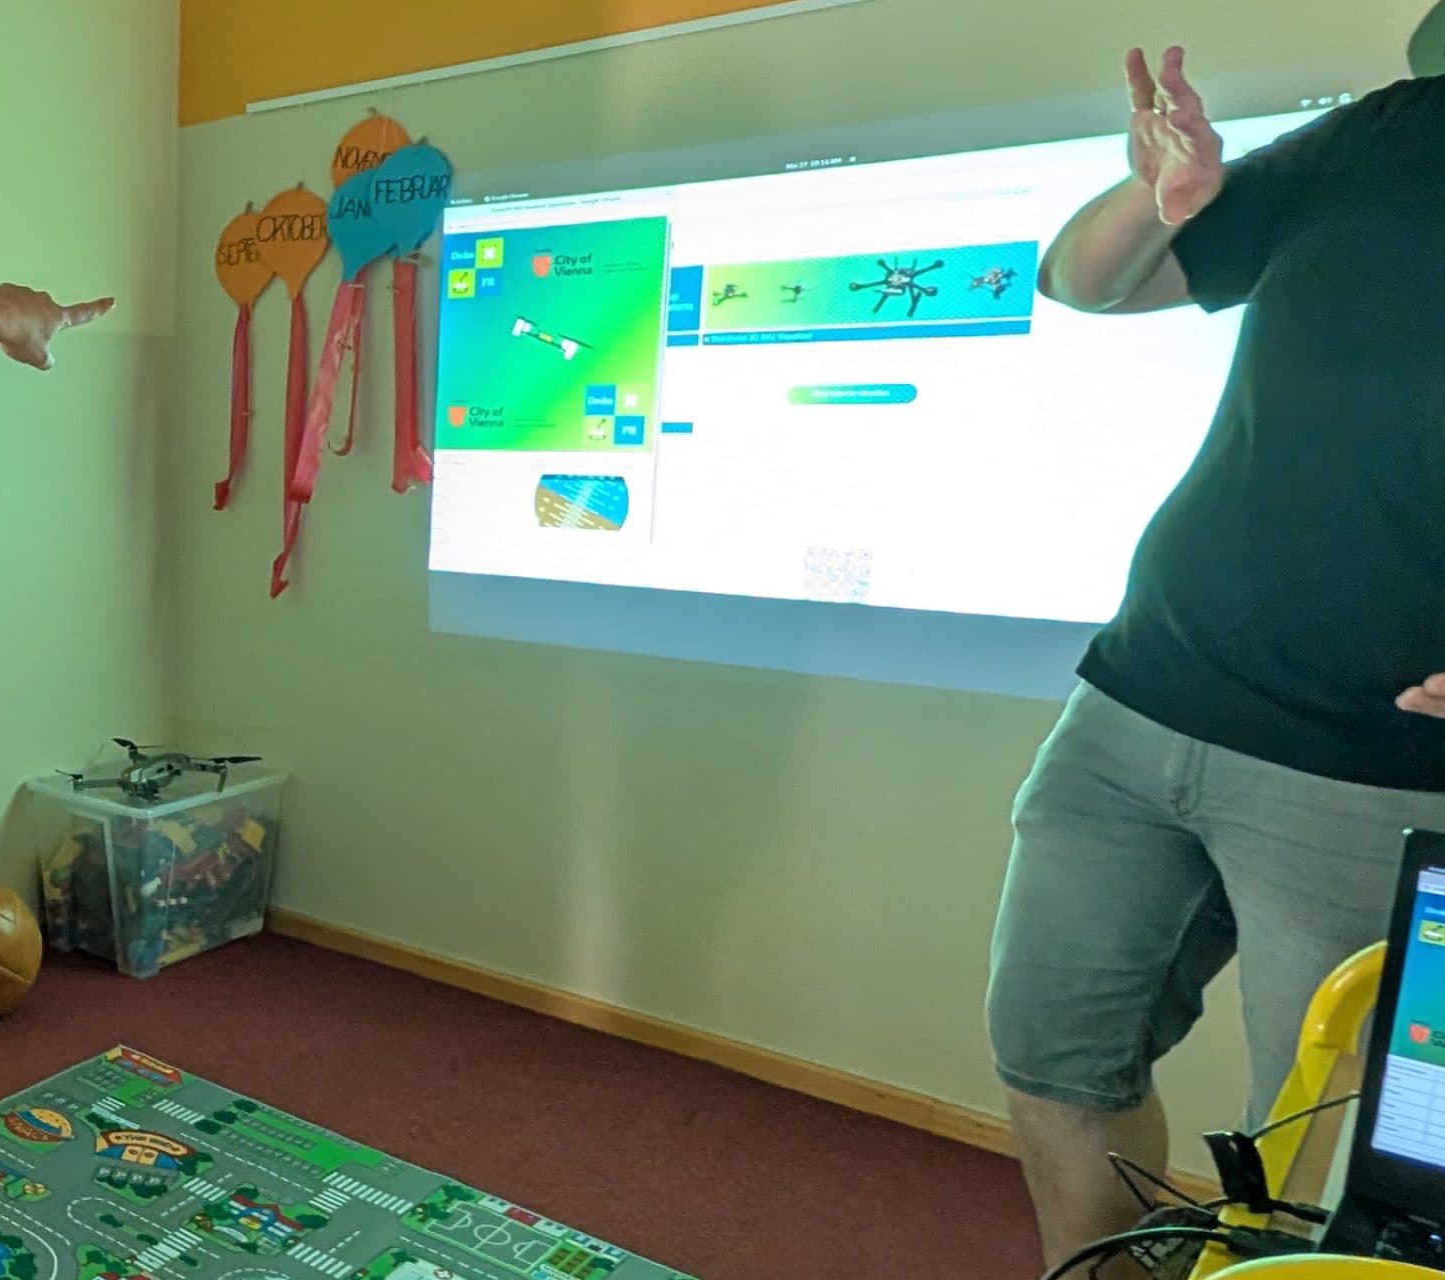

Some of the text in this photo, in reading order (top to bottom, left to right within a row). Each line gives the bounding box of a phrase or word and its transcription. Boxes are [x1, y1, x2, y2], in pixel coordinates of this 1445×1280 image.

[374, 173, 450, 205] FEBRUAR
[554, 253, 593, 267] City of
[554, 266, 593, 277] Vienna
[469, 406, 504, 420] City of
[469, 417, 504, 428] Vienna
